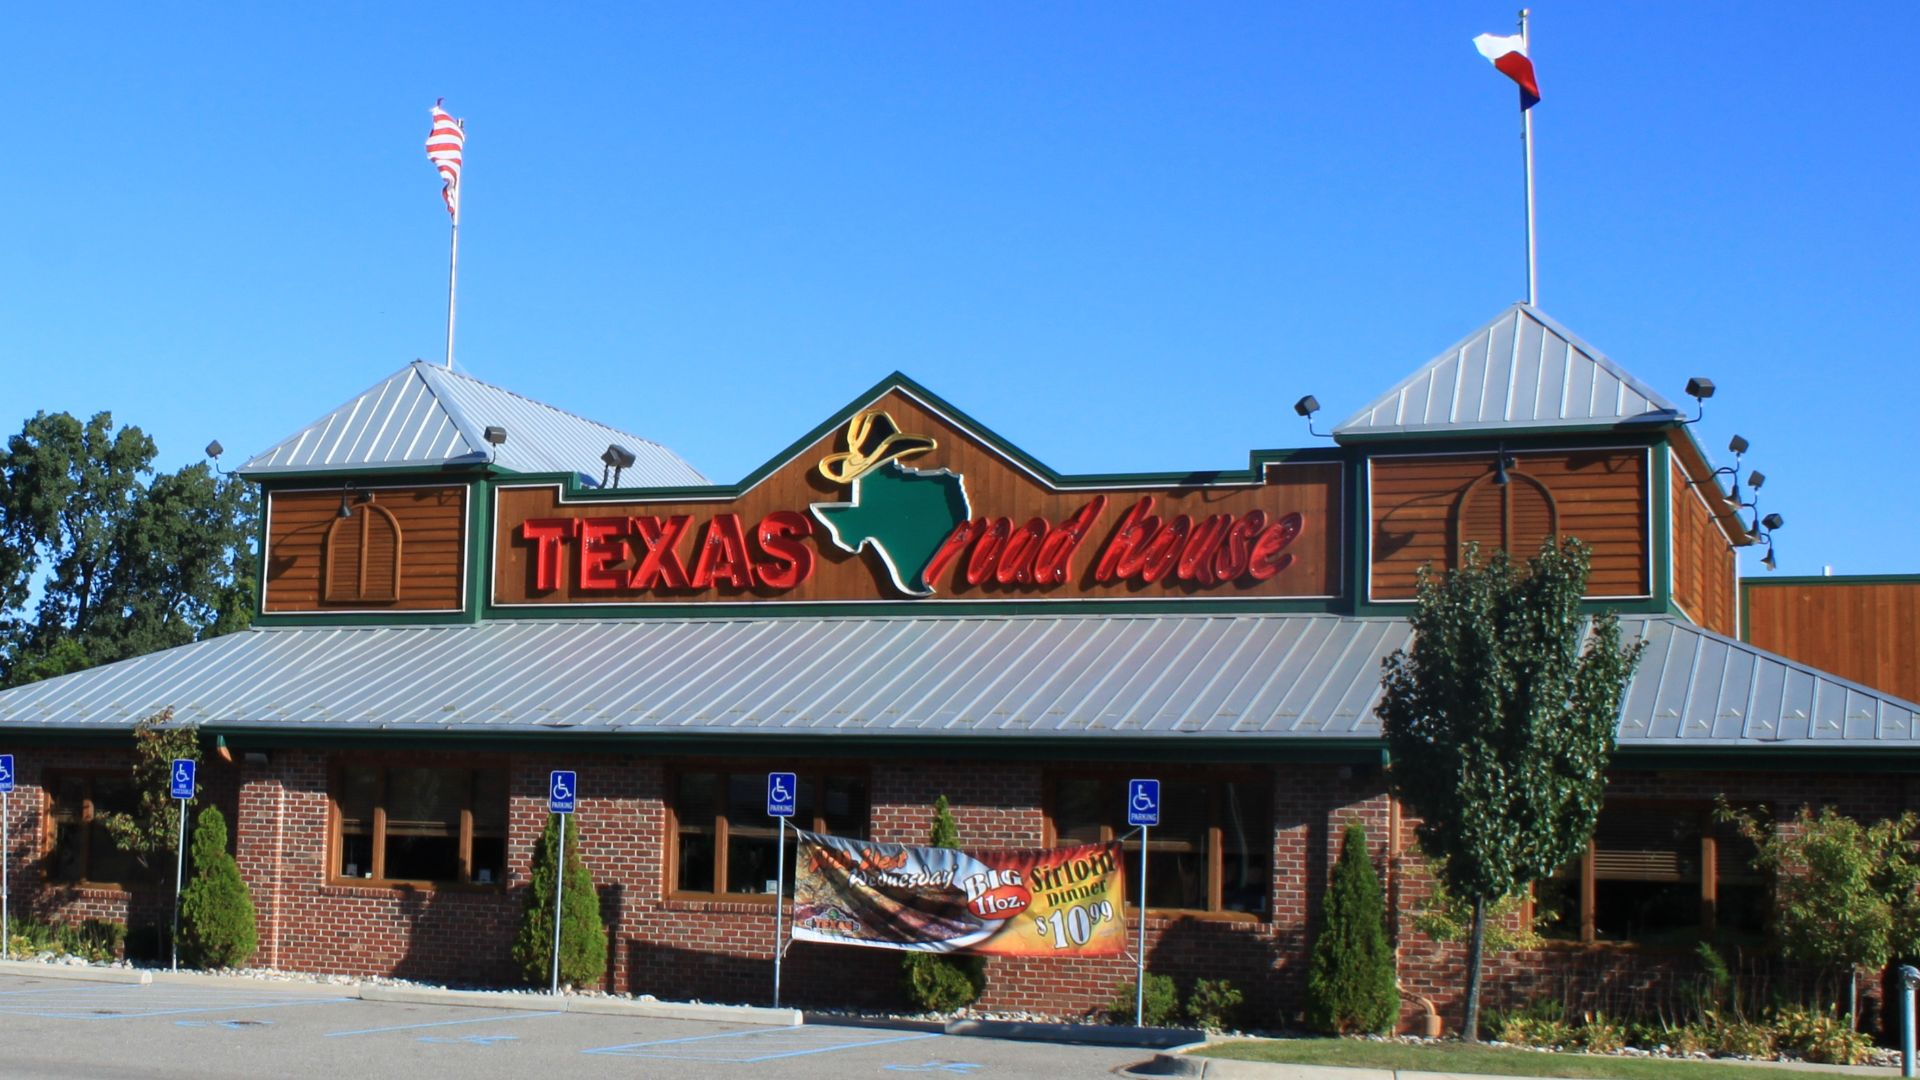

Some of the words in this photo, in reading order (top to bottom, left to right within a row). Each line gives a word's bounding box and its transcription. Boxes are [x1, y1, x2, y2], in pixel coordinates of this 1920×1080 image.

[523, 510, 815, 590] TEXAS
[551, 801, 573, 809] PARKING
[770, 804, 793, 812] PARKING
[1131, 812, 1157, 822] PARKING
[848, 862, 958, 889] Wednesday
[963, 868, 1023, 903] BIG
[1028, 850, 1116, 894] Sirloin
[974, 895, 1026, 916] 11oz.
